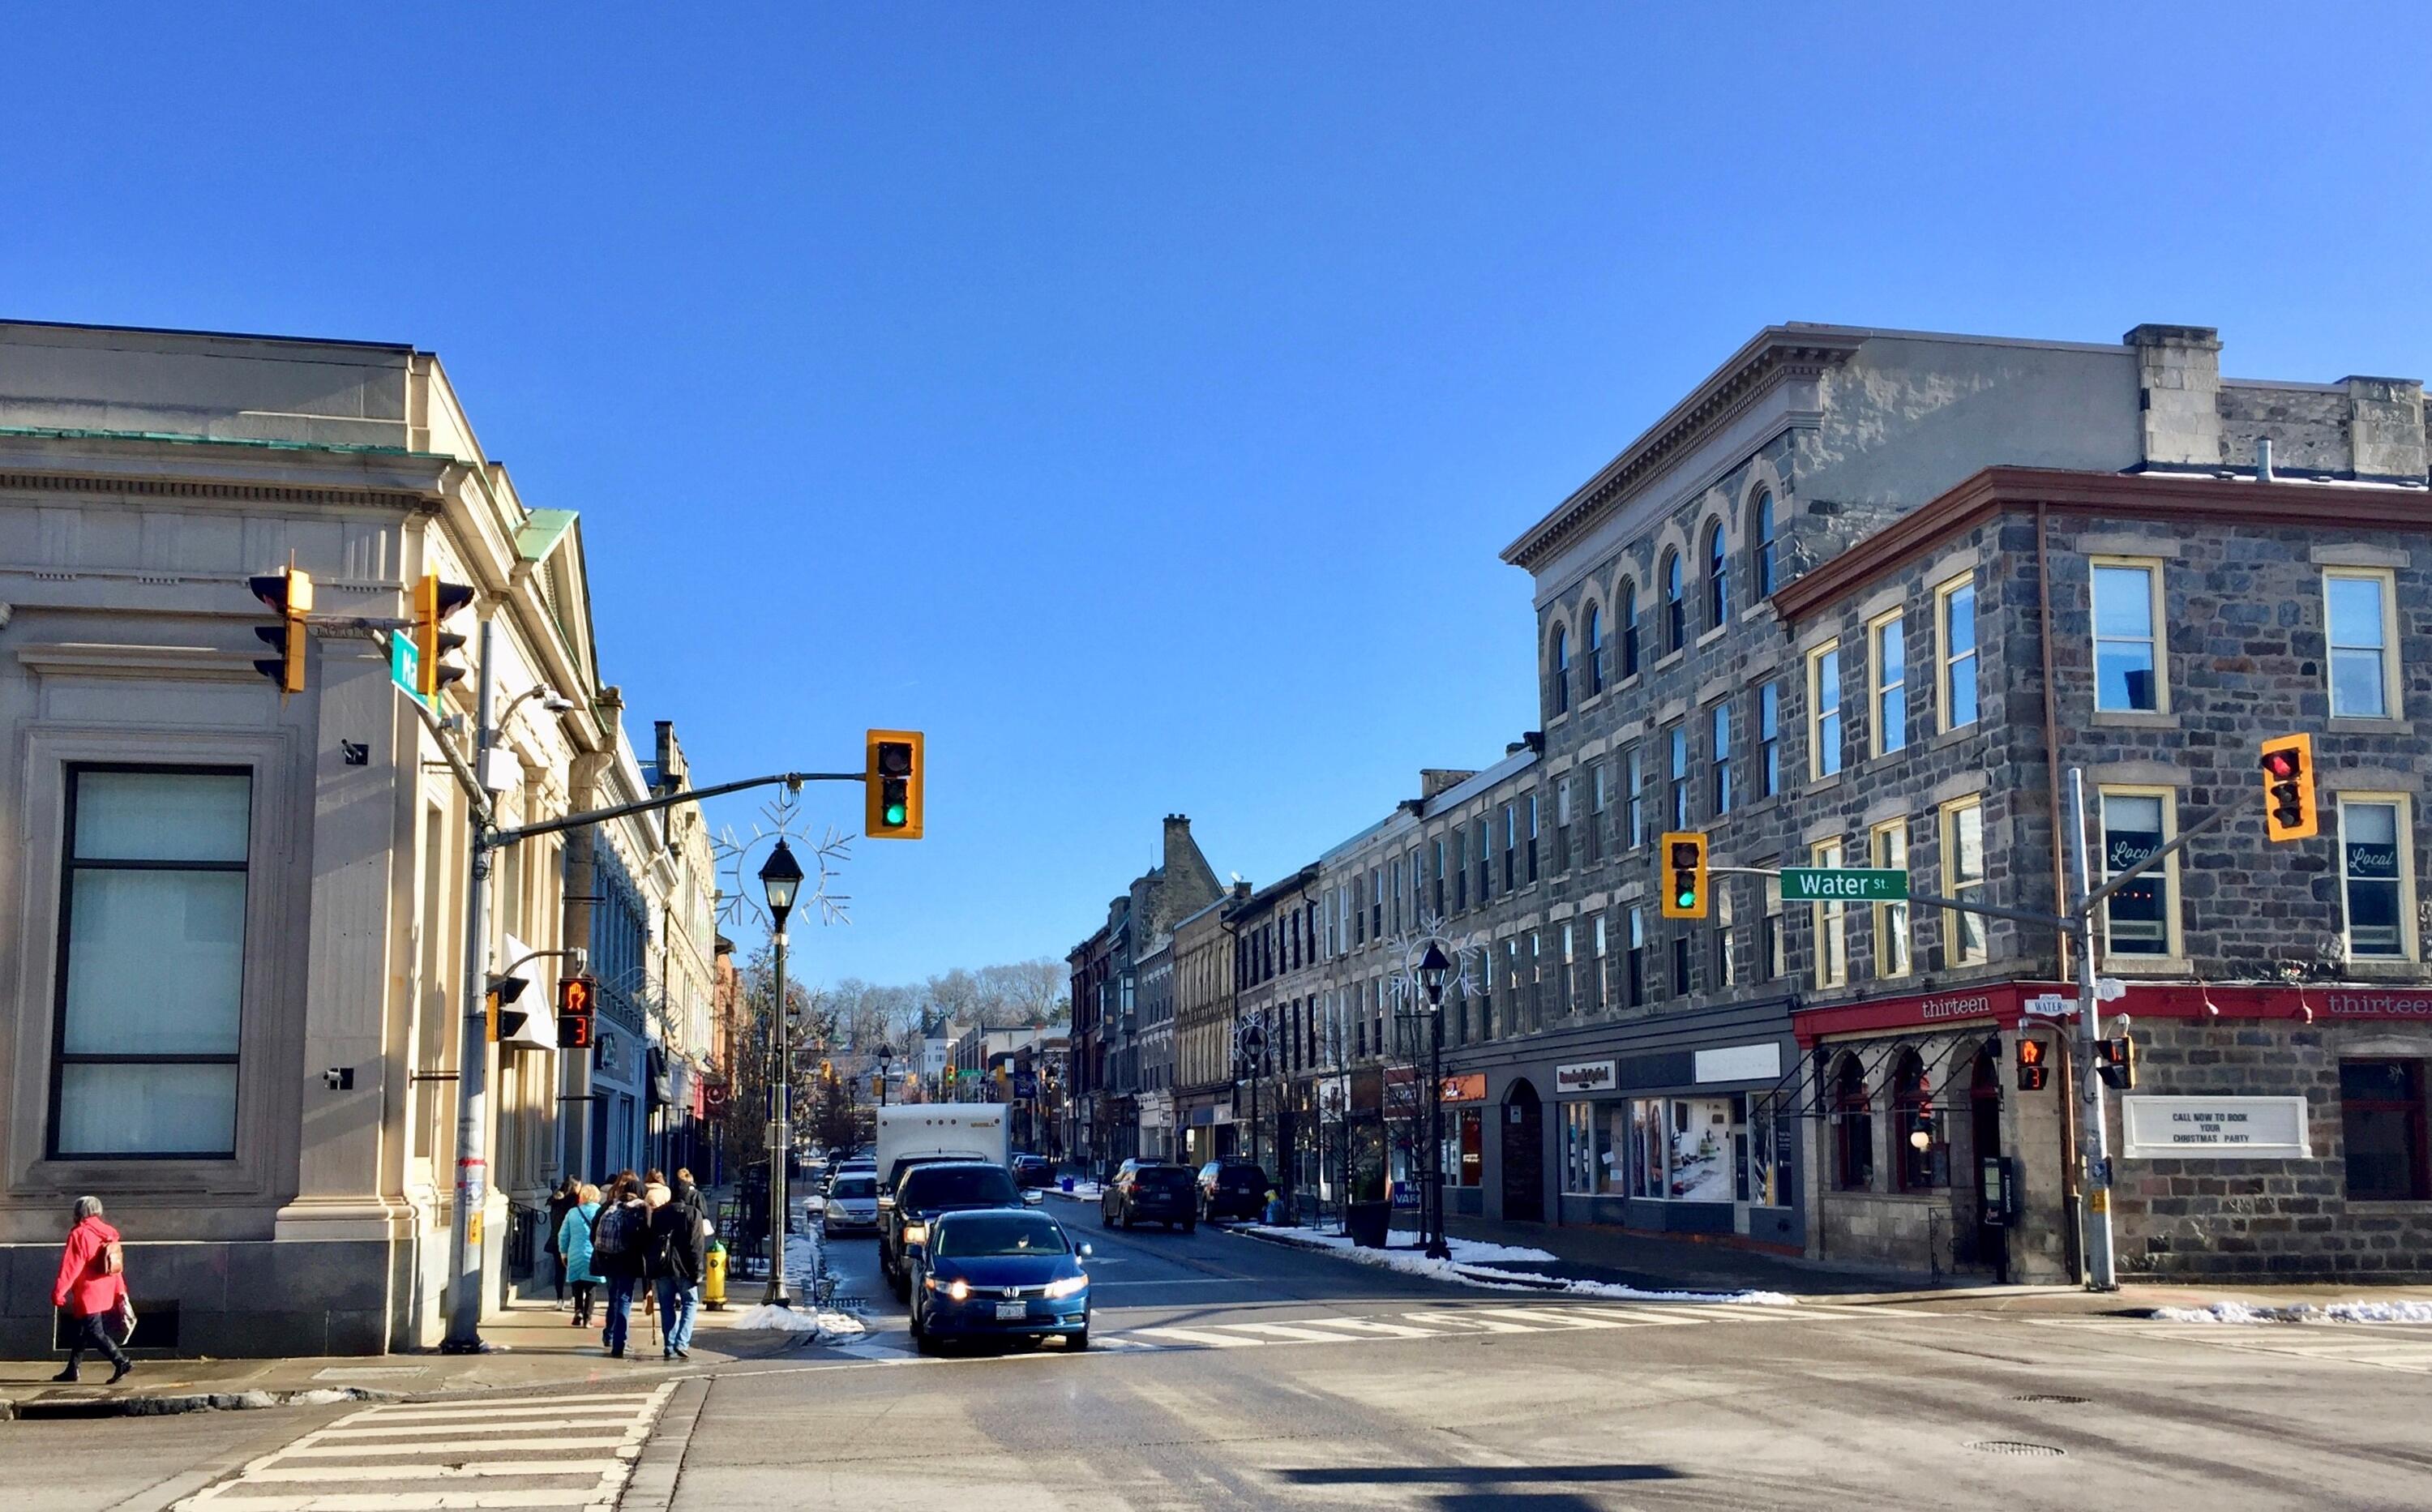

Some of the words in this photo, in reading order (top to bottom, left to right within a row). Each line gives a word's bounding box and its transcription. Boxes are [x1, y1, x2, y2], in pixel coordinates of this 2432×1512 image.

[402, 649, 417, 692] Ma
[2110, 841, 2157, 867] Local
[2349, 847, 2394, 873] Local
[1800, 874, 1868, 894] Water
[1873, 878, 1889, 889] St.
[1922, 997, 1989, 1018] thirteen
[2035, 1001, 2062, 1012] WATER
[2328, 995, 2432, 1013] thirtee
[576, 1017, 585, 1043] 3
[2032, 1069, 2039, 1087] 3
[2173, 1113, 2191, 1121] CALL
[2194, 1113, 2212, 1121] NOW
[2215, 1113, 2225, 1121] TO
[2228, 1113, 2248, 1122] BOOK
[2200, 1124, 2220, 1132] YOUR
[2173, 1134, 2217, 1142] CHRISTMAS
[2224, 1134, 2250, 1142] PARTY
